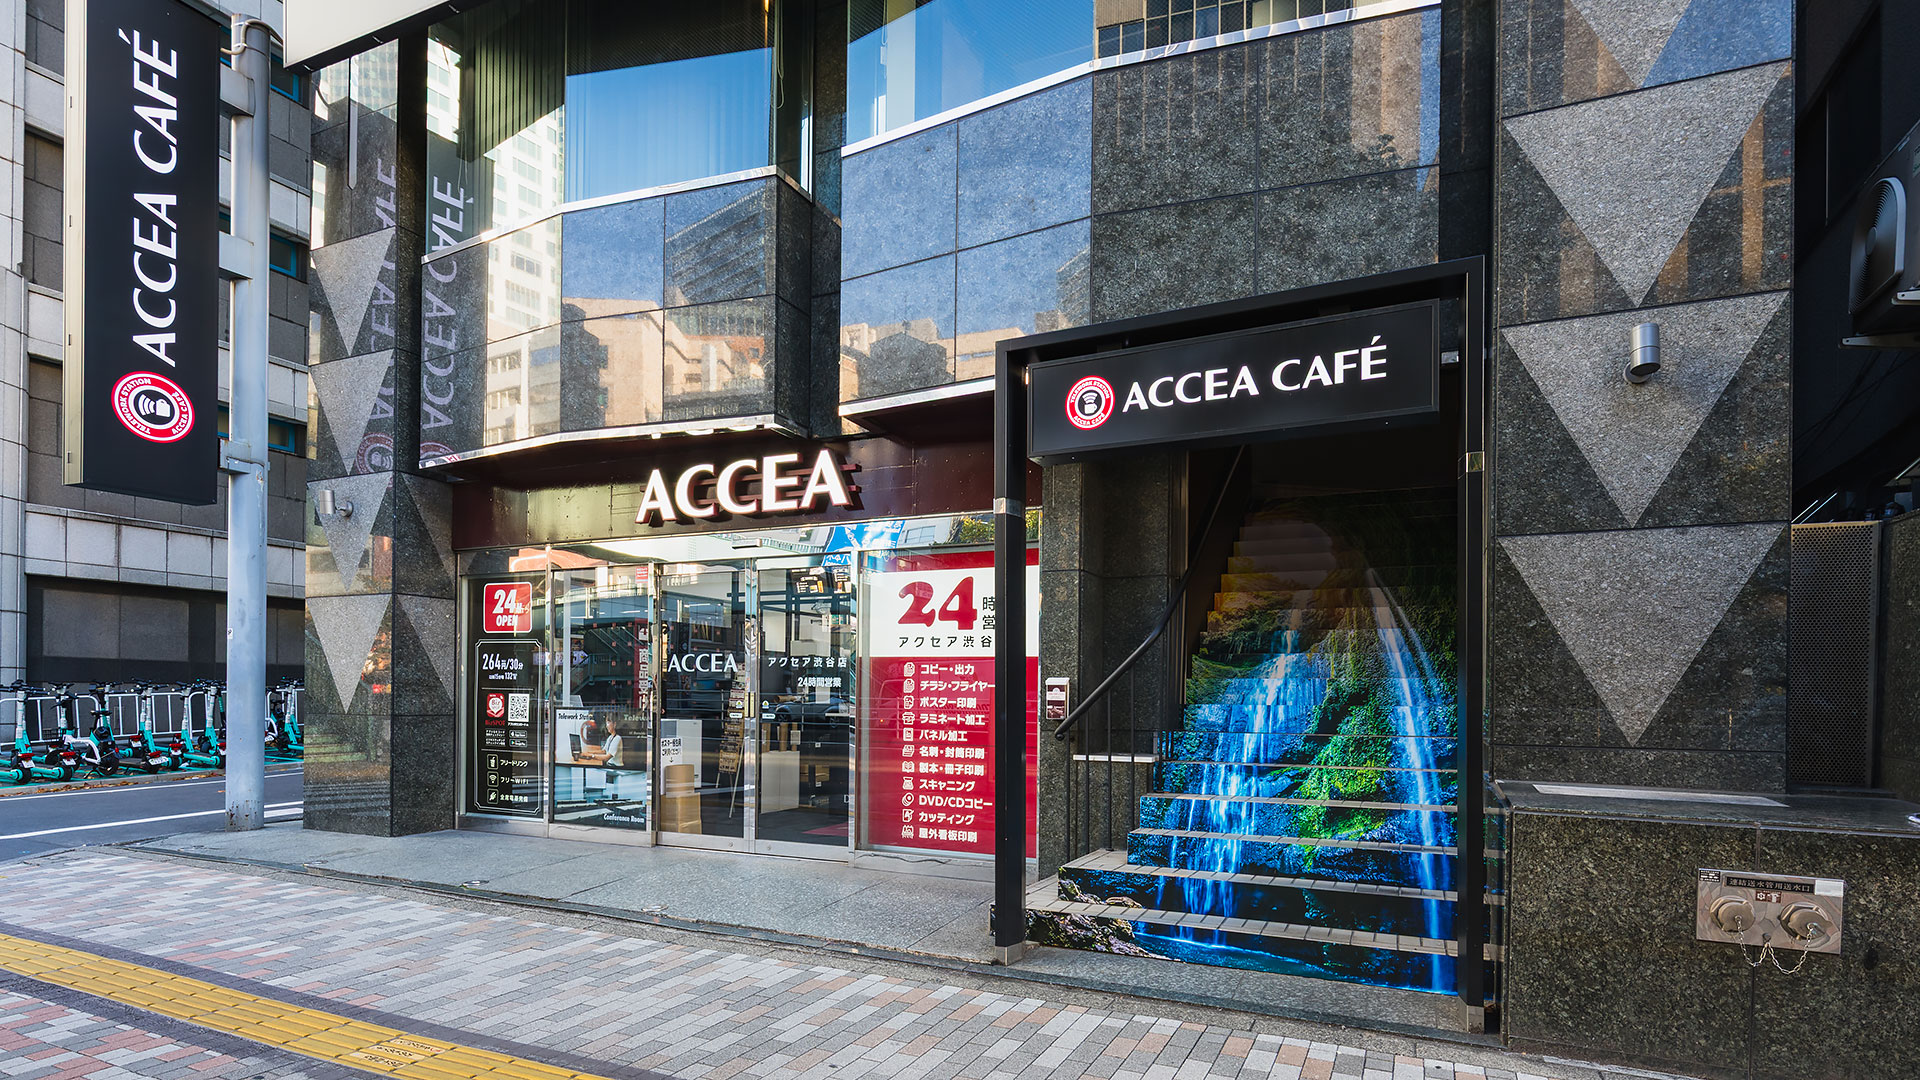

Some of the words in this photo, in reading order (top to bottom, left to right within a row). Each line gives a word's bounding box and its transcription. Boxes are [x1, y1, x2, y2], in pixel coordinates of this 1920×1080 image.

[118, 28, 178, 174] CAFÉ
[132, 193, 178, 368] ACCEA
[1121, 365, 1260, 412] ACCEA
[1272, 335, 1387, 391] CAFÉ
[121, 378, 152, 396] STATION
[120, 396, 150, 434] TELEWORK
[172, 414, 188, 434] ACCEA
[635, 448, 850, 524] ACCEA
[898, 576, 978, 630] 24
[496, 615, 518, 626] OPEN
[899, 635, 992, 648] アクセア渋谷
[668, 653, 738, 672] ACCEA
[768, 656, 847, 668] アクセア渋谷店
[920, 664, 974, 675] コピー・出力
[798, 677, 842, 688] 24時間営業
[920, 681, 995, 692] チラシ・フライヤー
[920, 697, 976, 709] ポスター印刷
[919, 714, 985, 726] ラミネート加工
[919, 730, 968, 741] パネル加工
[919, 779, 976, 792] スキャニング
[919, 795, 993, 809] DVD/CDコピー
[918, 812, 975, 825] カッティング
